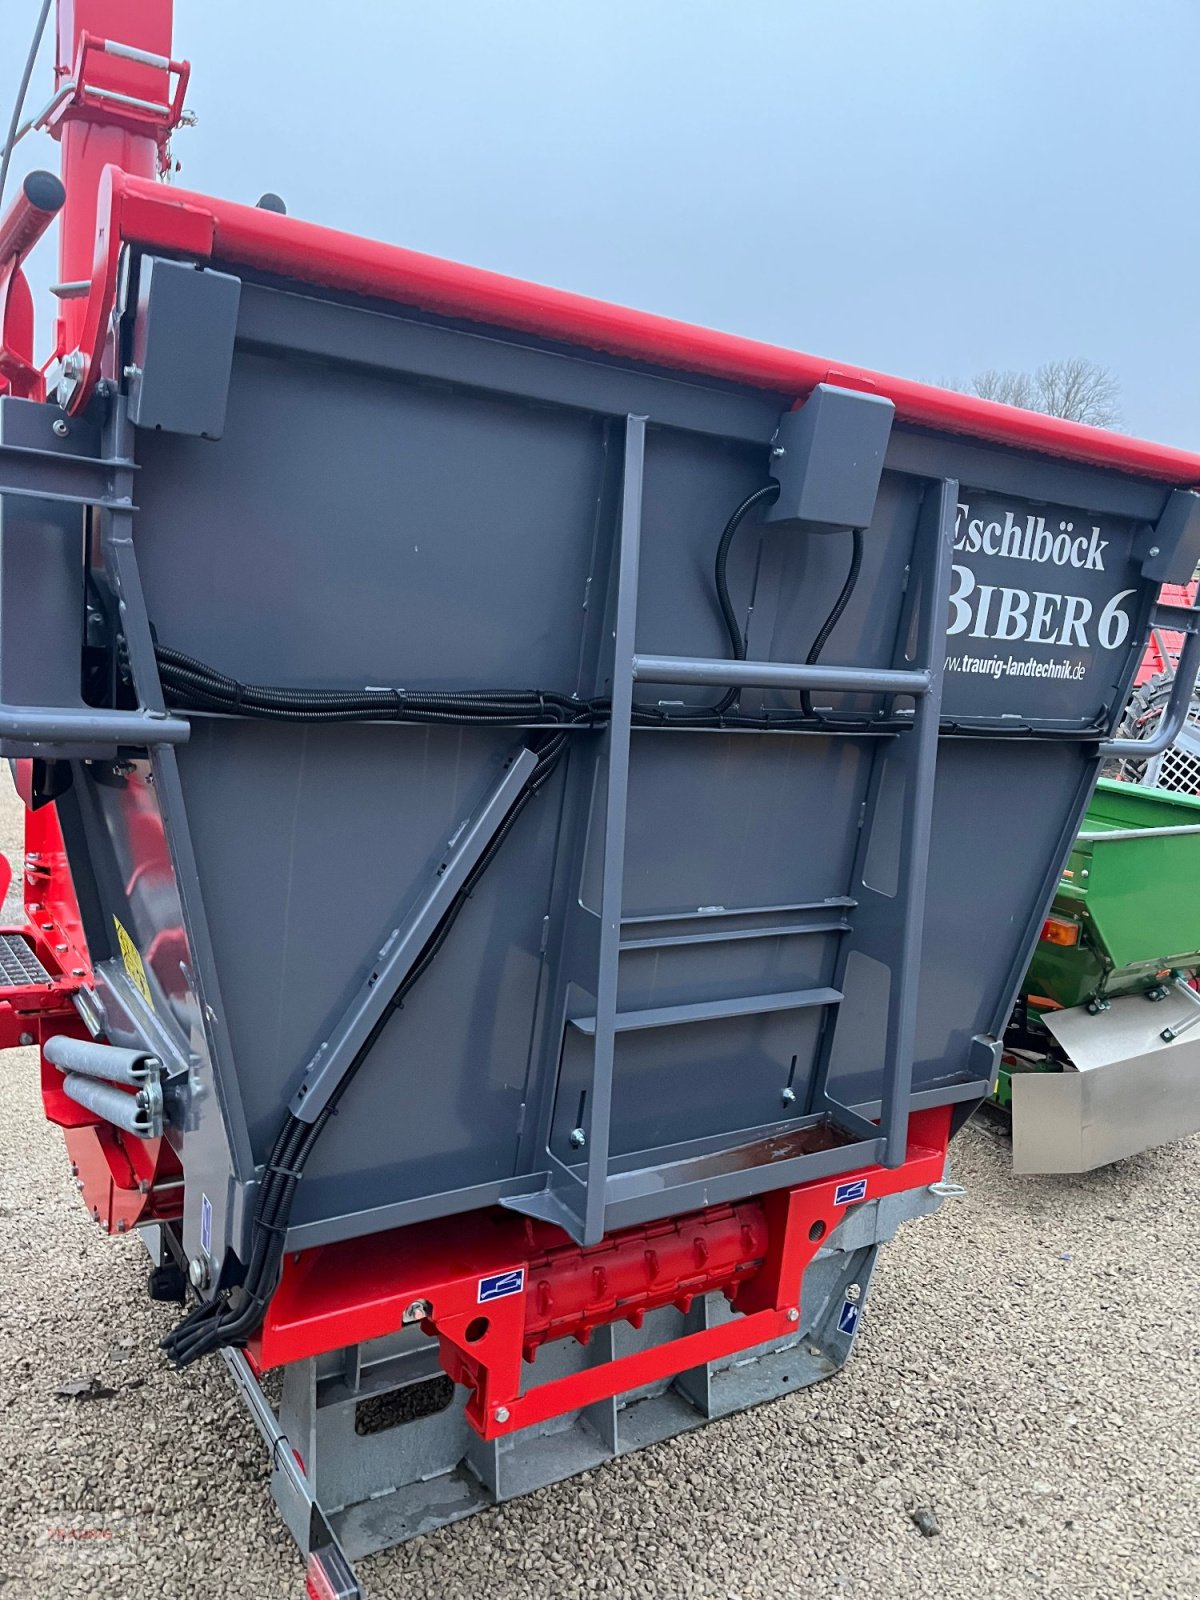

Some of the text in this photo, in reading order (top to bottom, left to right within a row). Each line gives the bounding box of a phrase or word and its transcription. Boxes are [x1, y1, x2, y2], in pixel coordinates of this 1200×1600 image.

[953, 503, 1109, 571] Eschlböck
[1098, 588, 1138, 650] 6
[943, 653, 1086, 681] w.traurig-landtechnik.de
